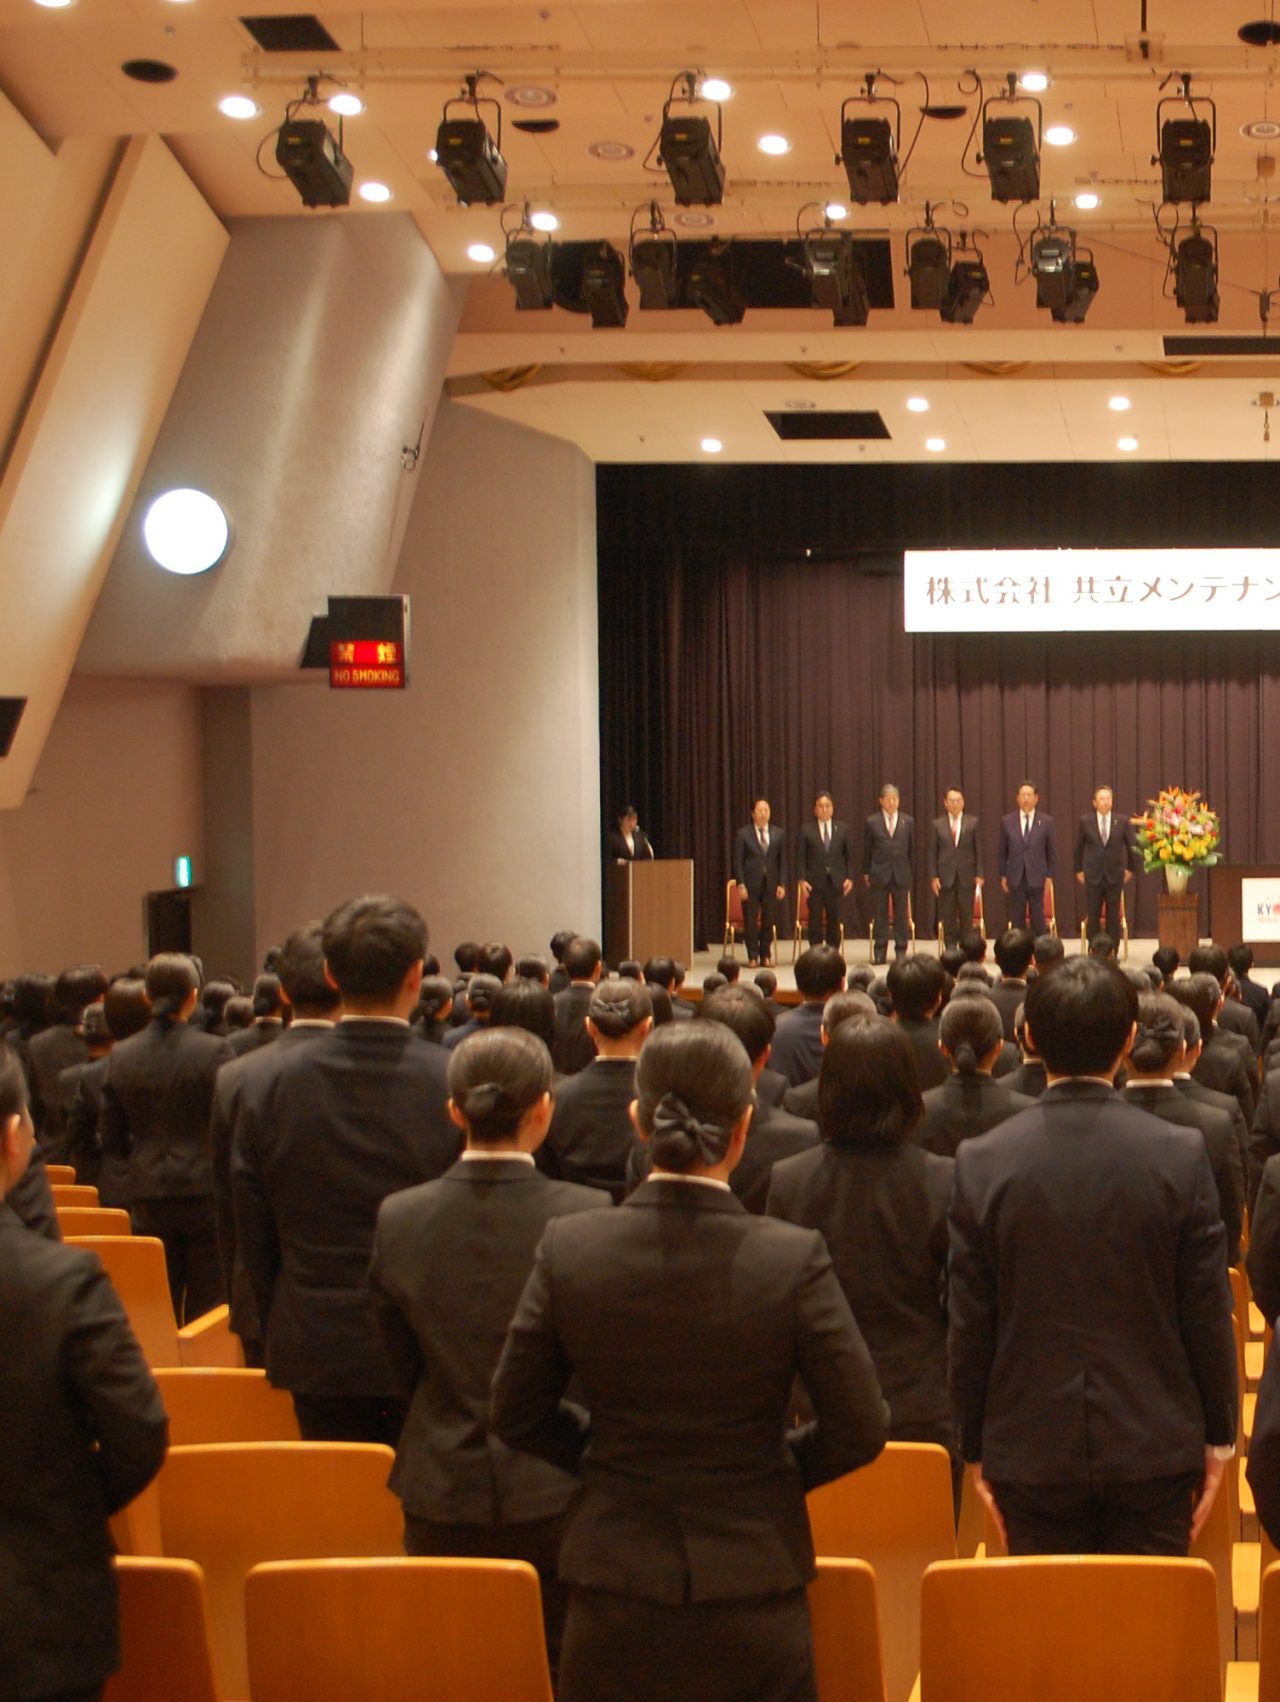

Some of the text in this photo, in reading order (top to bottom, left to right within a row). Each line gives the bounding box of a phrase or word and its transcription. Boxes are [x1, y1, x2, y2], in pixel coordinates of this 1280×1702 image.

[926, 576, 1054, 605] 株式会社
[335, 669, 400, 682] NO SMOKING
